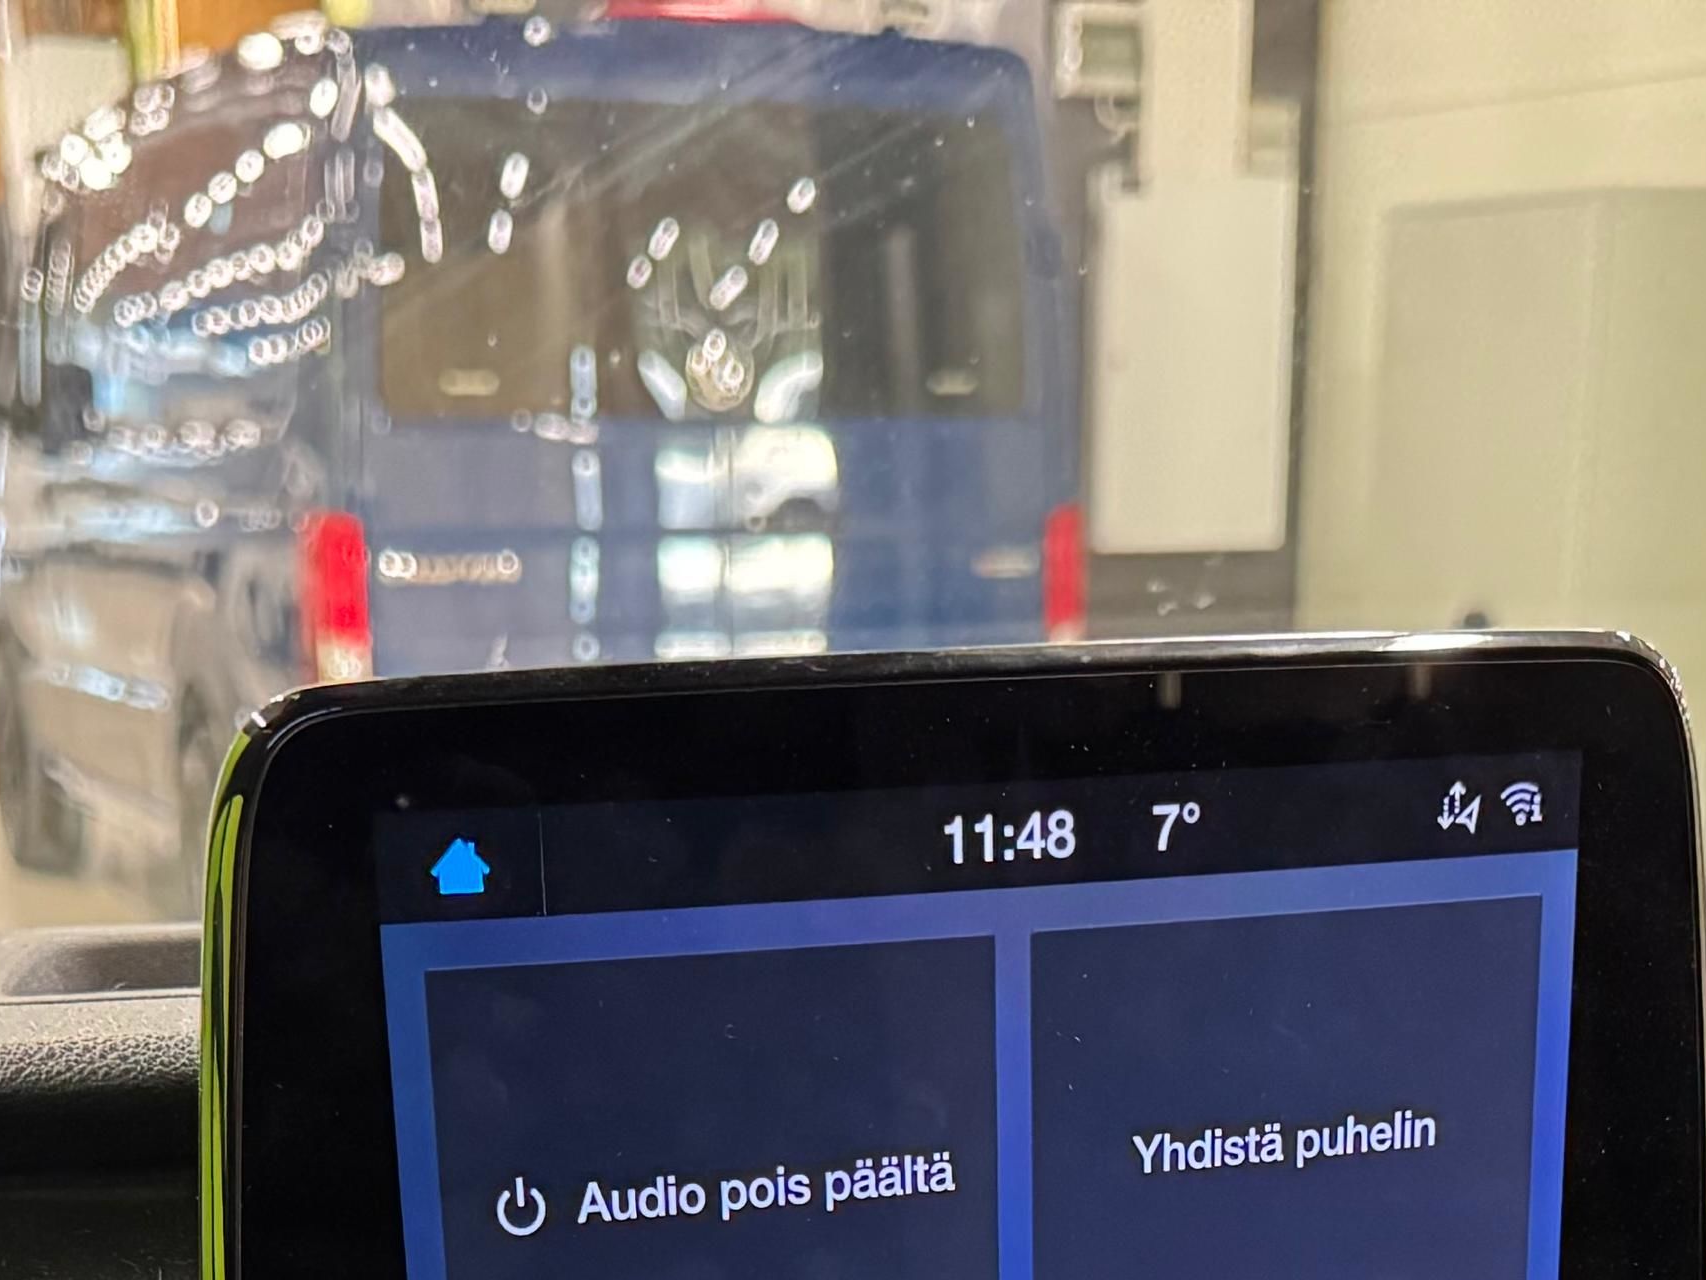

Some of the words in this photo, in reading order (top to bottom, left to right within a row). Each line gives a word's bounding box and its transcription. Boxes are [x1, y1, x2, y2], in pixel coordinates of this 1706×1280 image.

[944, 809, 1076, 865] 11:48
[1152, 802, 1201, 852] 7°
[1132, 1122, 1285, 1175] Yhdistä
[1296, 1109, 1437, 1169] puhelin
[577, 1174, 706, 1224] Audio
[720, 1165, 812, 1221] pois
[824, 1151, 956, 1212] päältä
